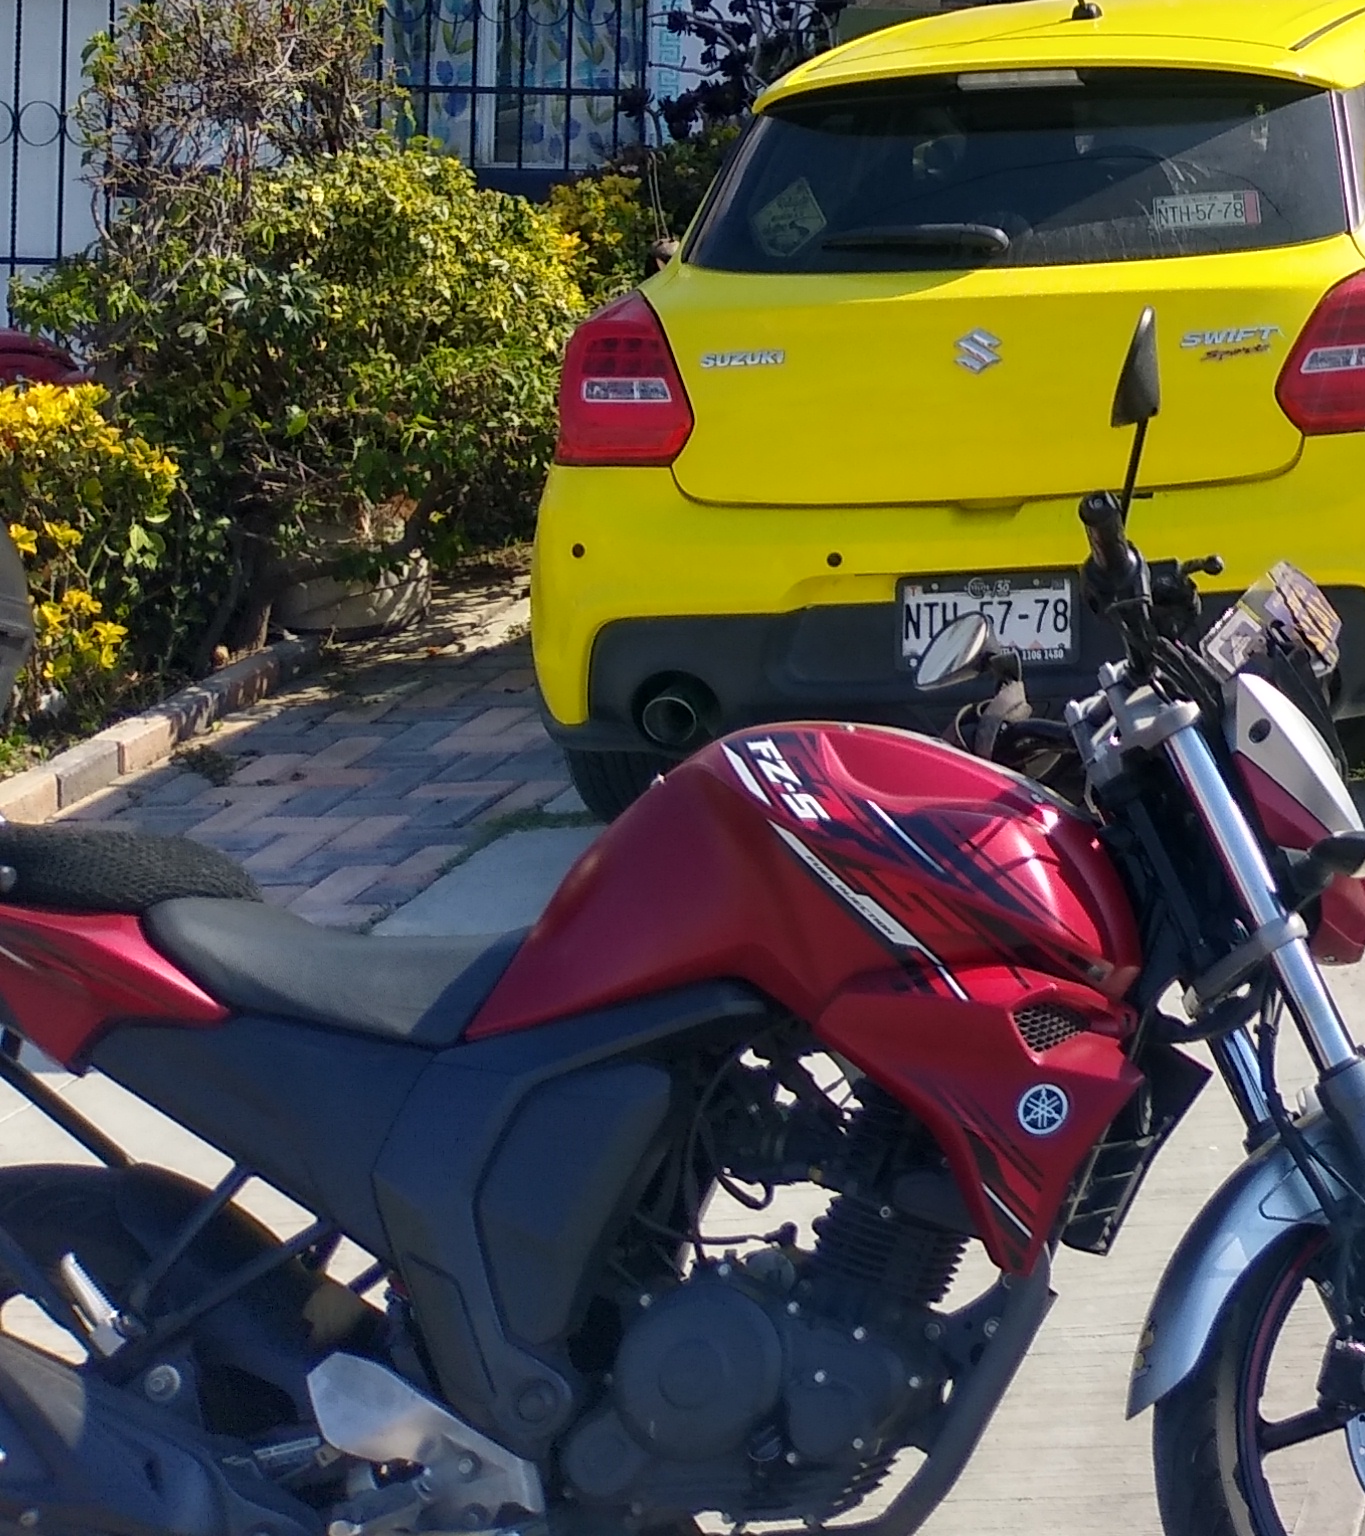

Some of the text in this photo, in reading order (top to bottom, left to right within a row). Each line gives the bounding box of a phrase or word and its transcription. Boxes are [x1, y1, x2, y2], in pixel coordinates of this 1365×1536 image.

[1158, 201, 1244, 224] NTH-57-78
[1180, 325, 1281, 348] SWIFT
[700, 349, 785, 368] SUZUKI
[746, 737, 832, 821] FZ-S
